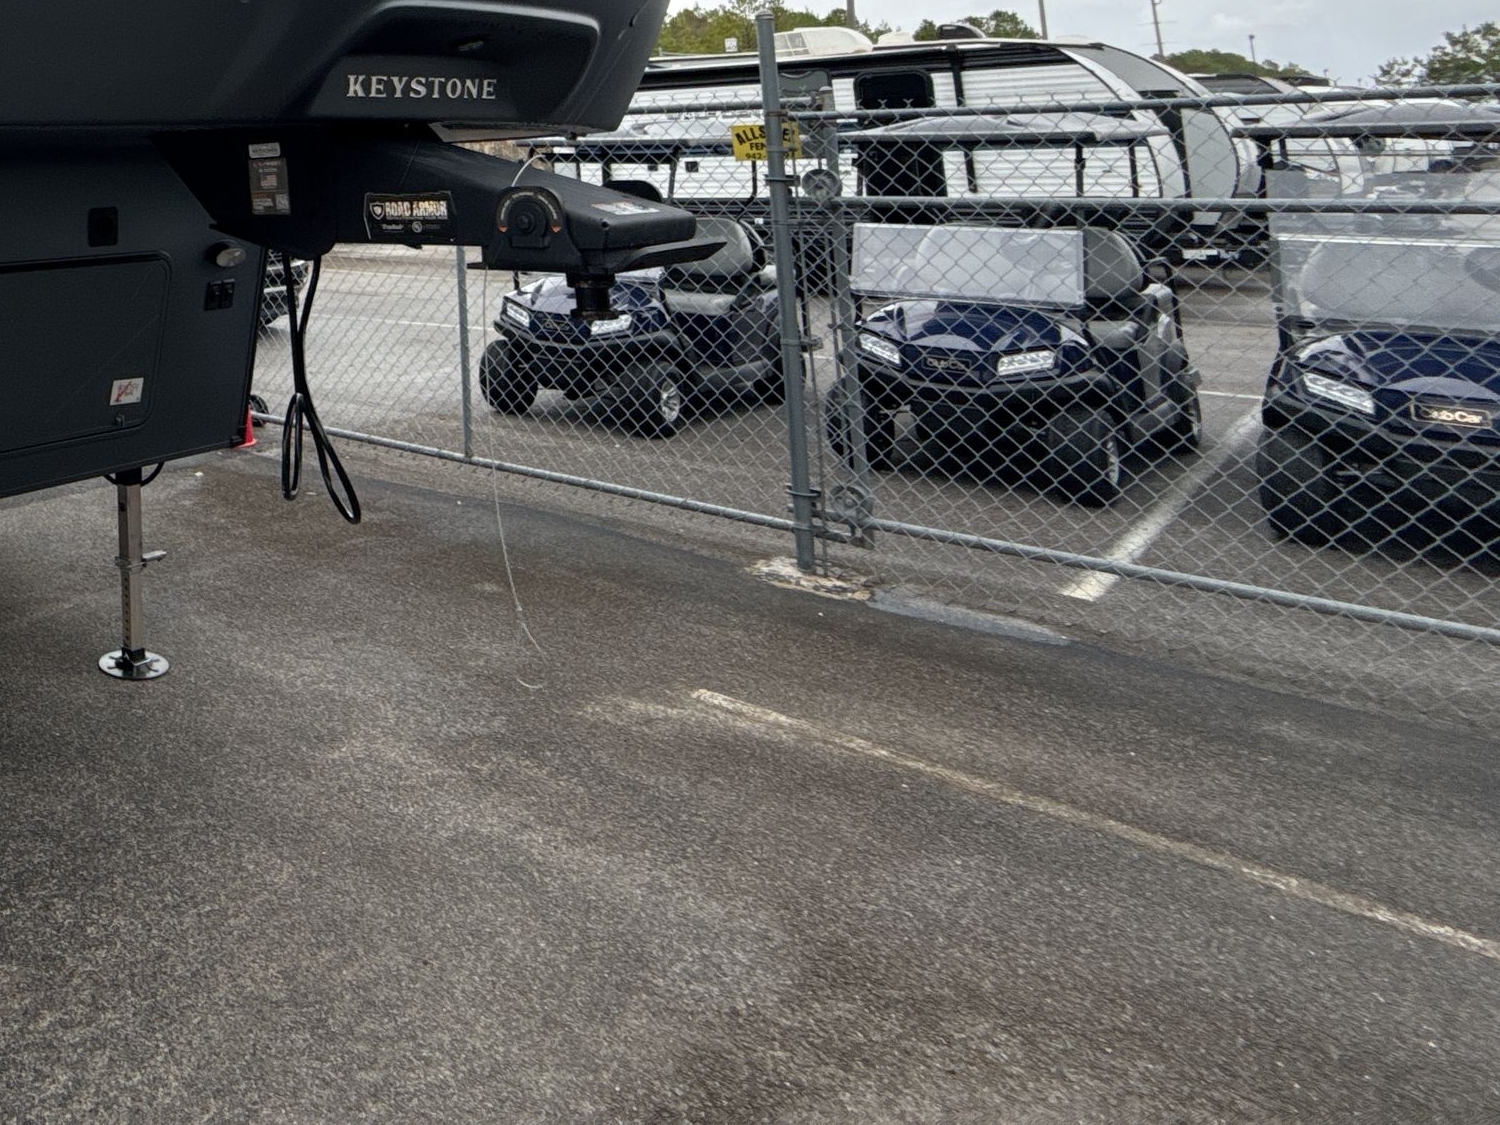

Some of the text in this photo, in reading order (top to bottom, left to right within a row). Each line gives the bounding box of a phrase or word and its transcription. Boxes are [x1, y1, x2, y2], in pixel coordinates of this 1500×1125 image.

[346, 74, 498, 100] KEYSTONE
[385, 200, 448, 217] ROAD ARMOR
